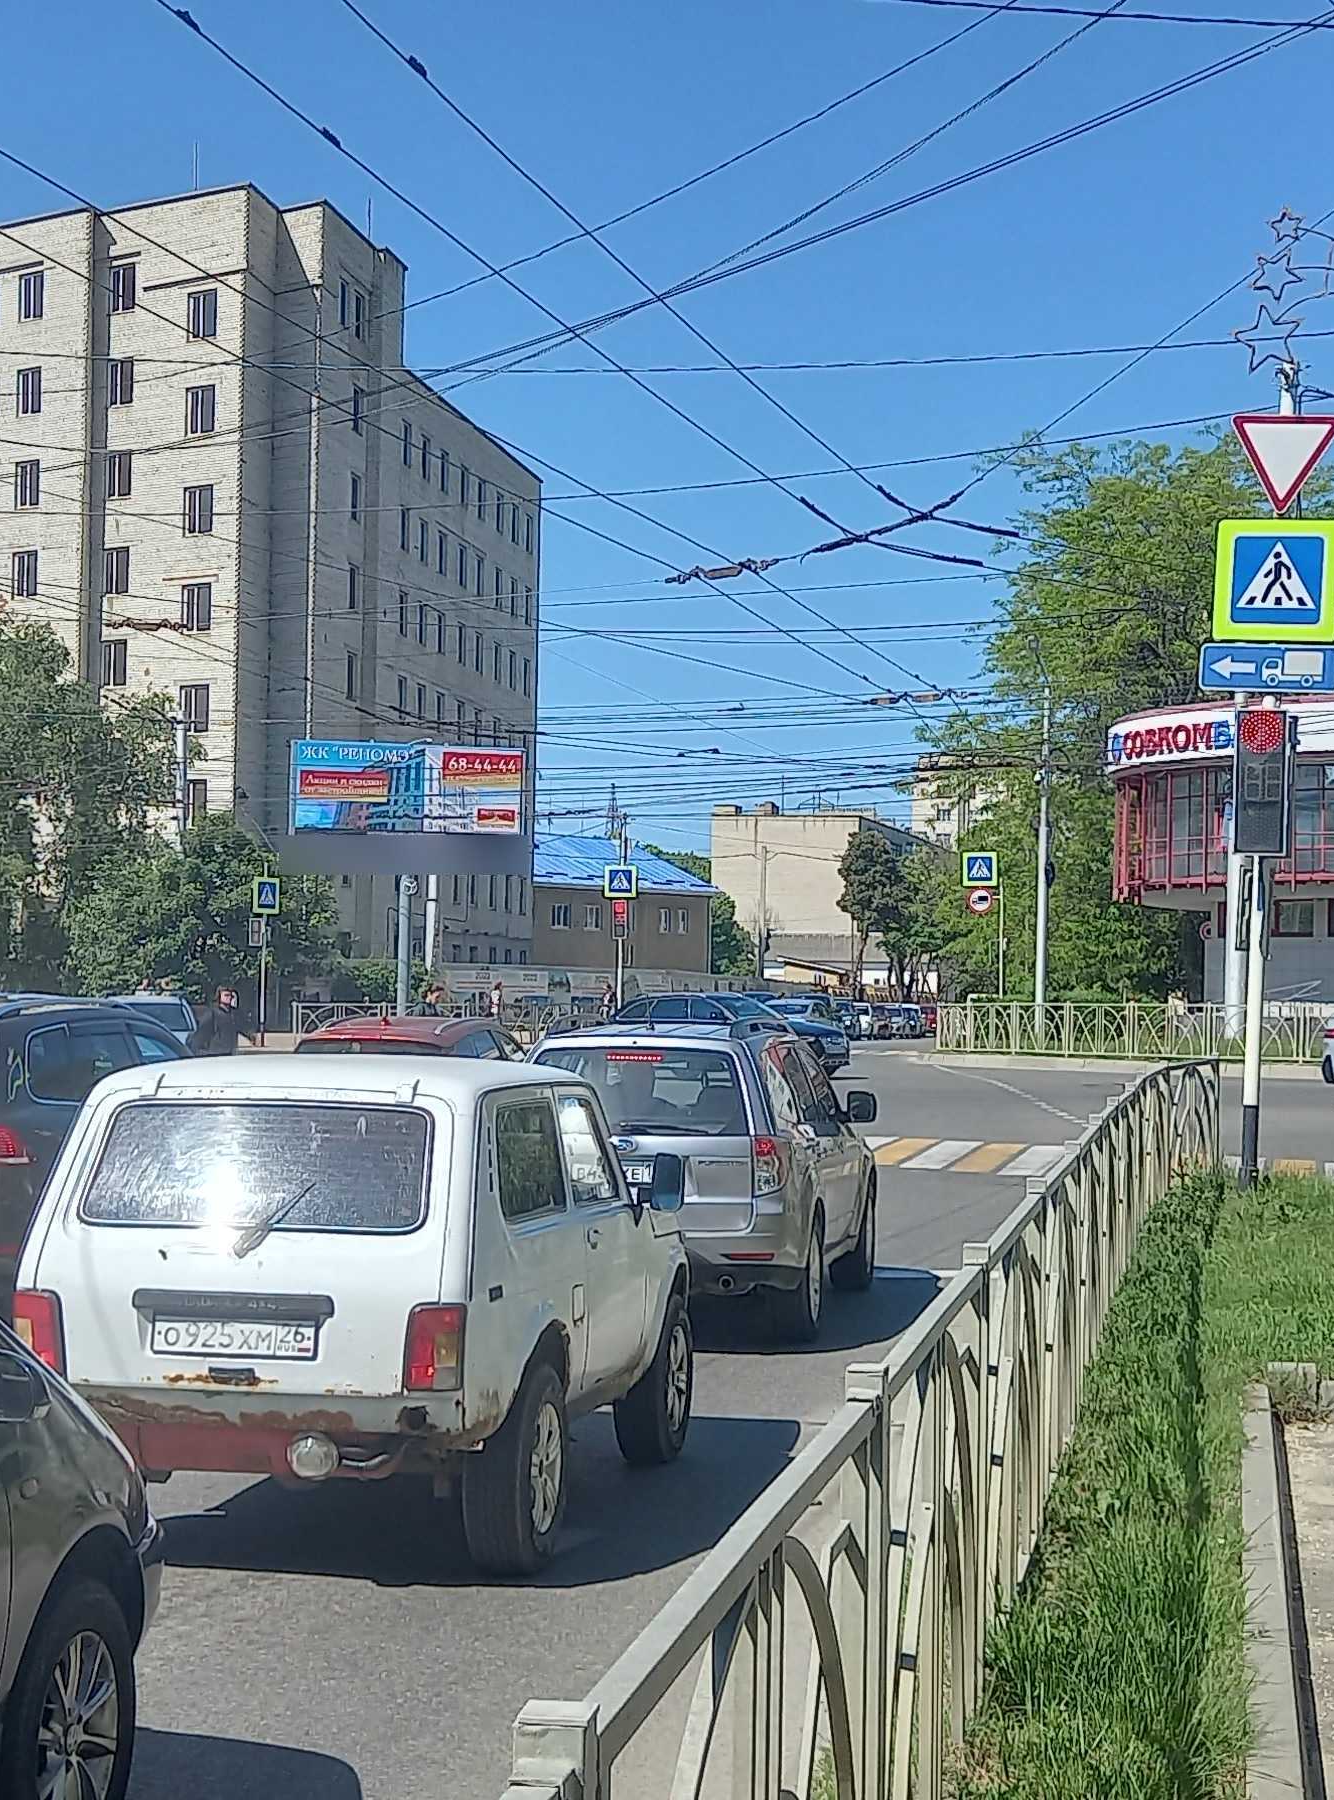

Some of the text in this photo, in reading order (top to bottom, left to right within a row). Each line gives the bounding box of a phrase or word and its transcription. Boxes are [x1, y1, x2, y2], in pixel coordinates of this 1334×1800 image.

[1123, 720, 1234, 760] СОВКОМБ
[301, 746, 329, 759] ЖК
[448, 757, 516, 773] 68-44-44
[164, 1322, 306, 1350] О925ХМ 26
